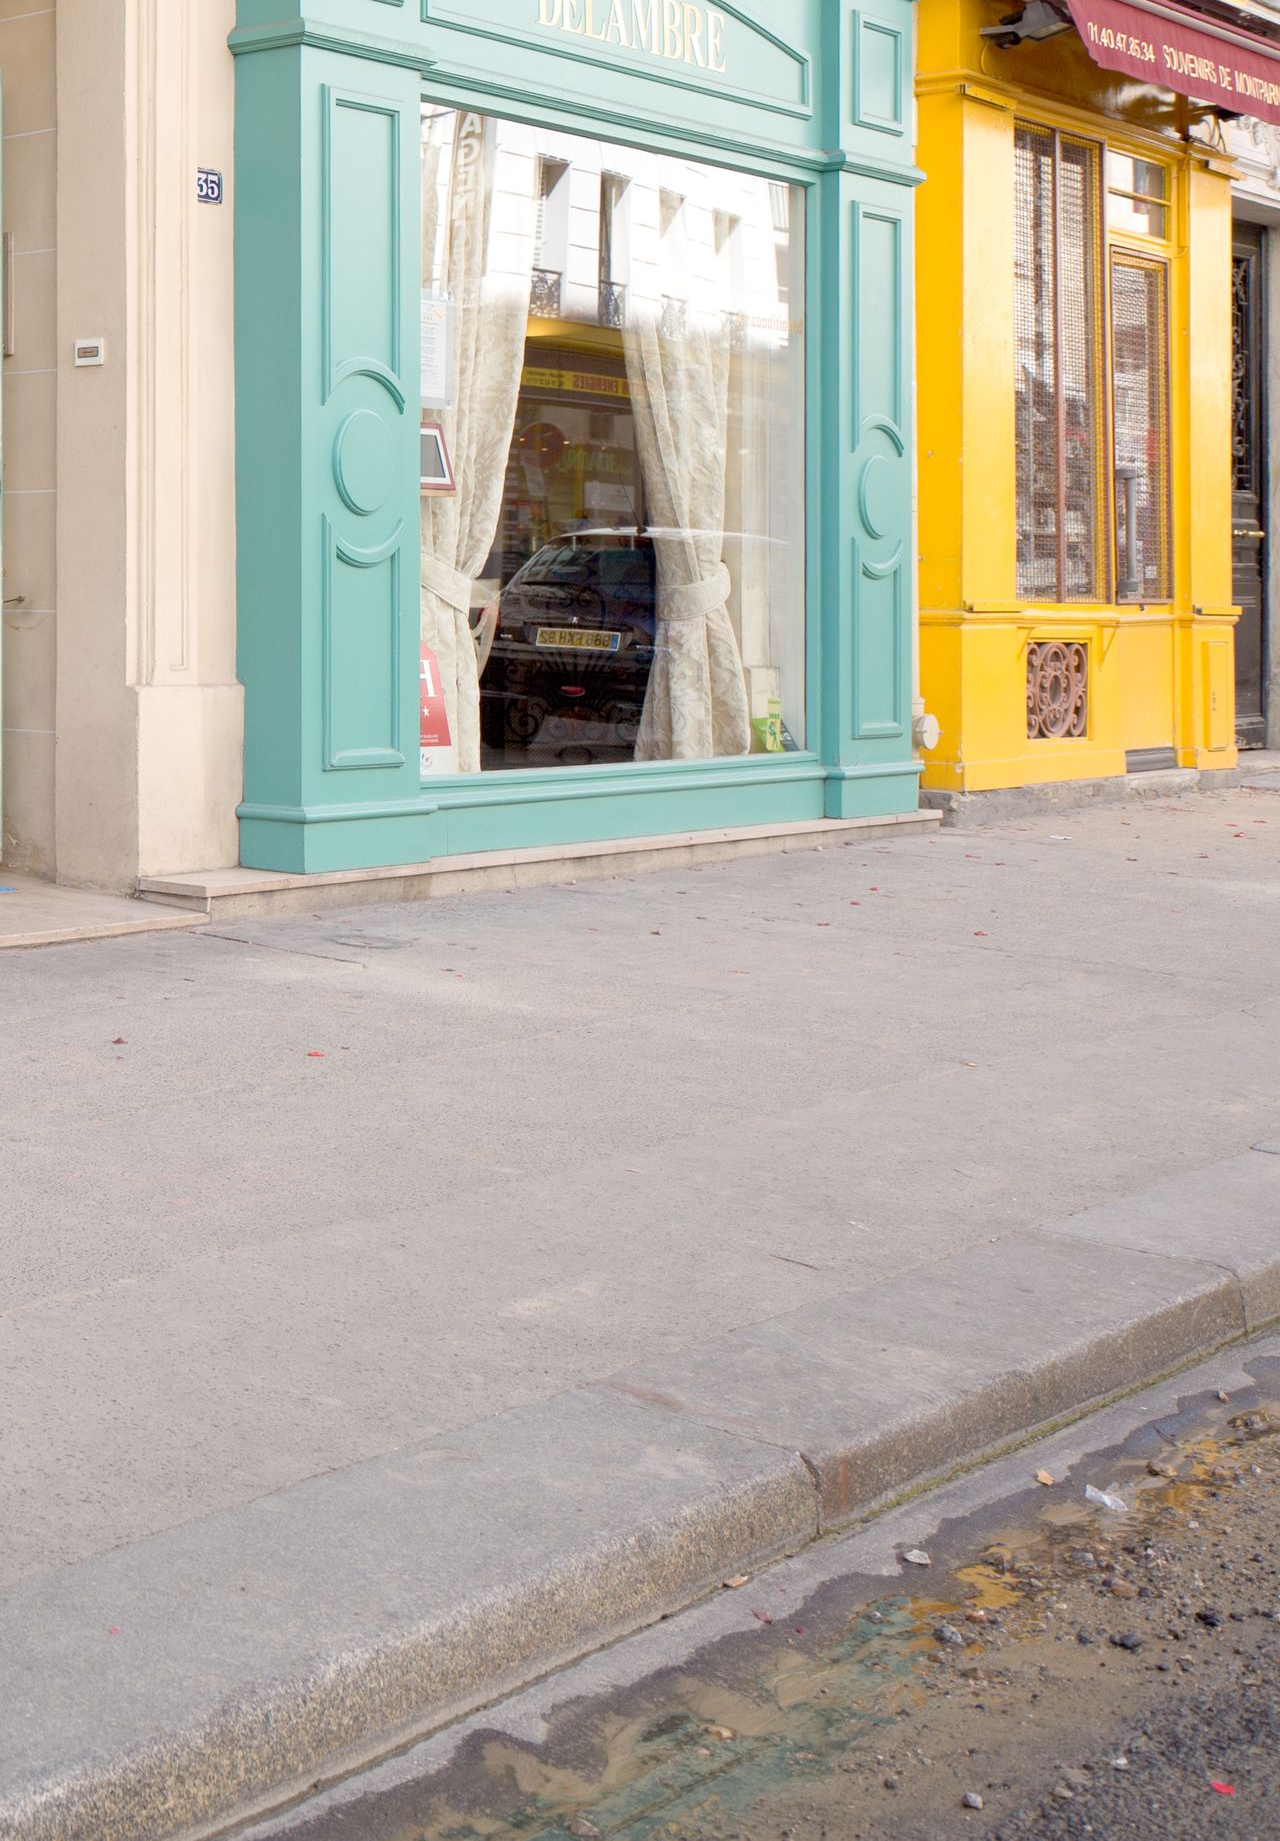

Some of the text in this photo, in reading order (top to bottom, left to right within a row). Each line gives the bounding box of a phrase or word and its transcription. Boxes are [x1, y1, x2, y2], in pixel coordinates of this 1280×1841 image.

[1162, 44, 1217, 84] SOUVENIRS
[1218, 65, 1232, 91] DE
[197, 173, 219, 198] 35
